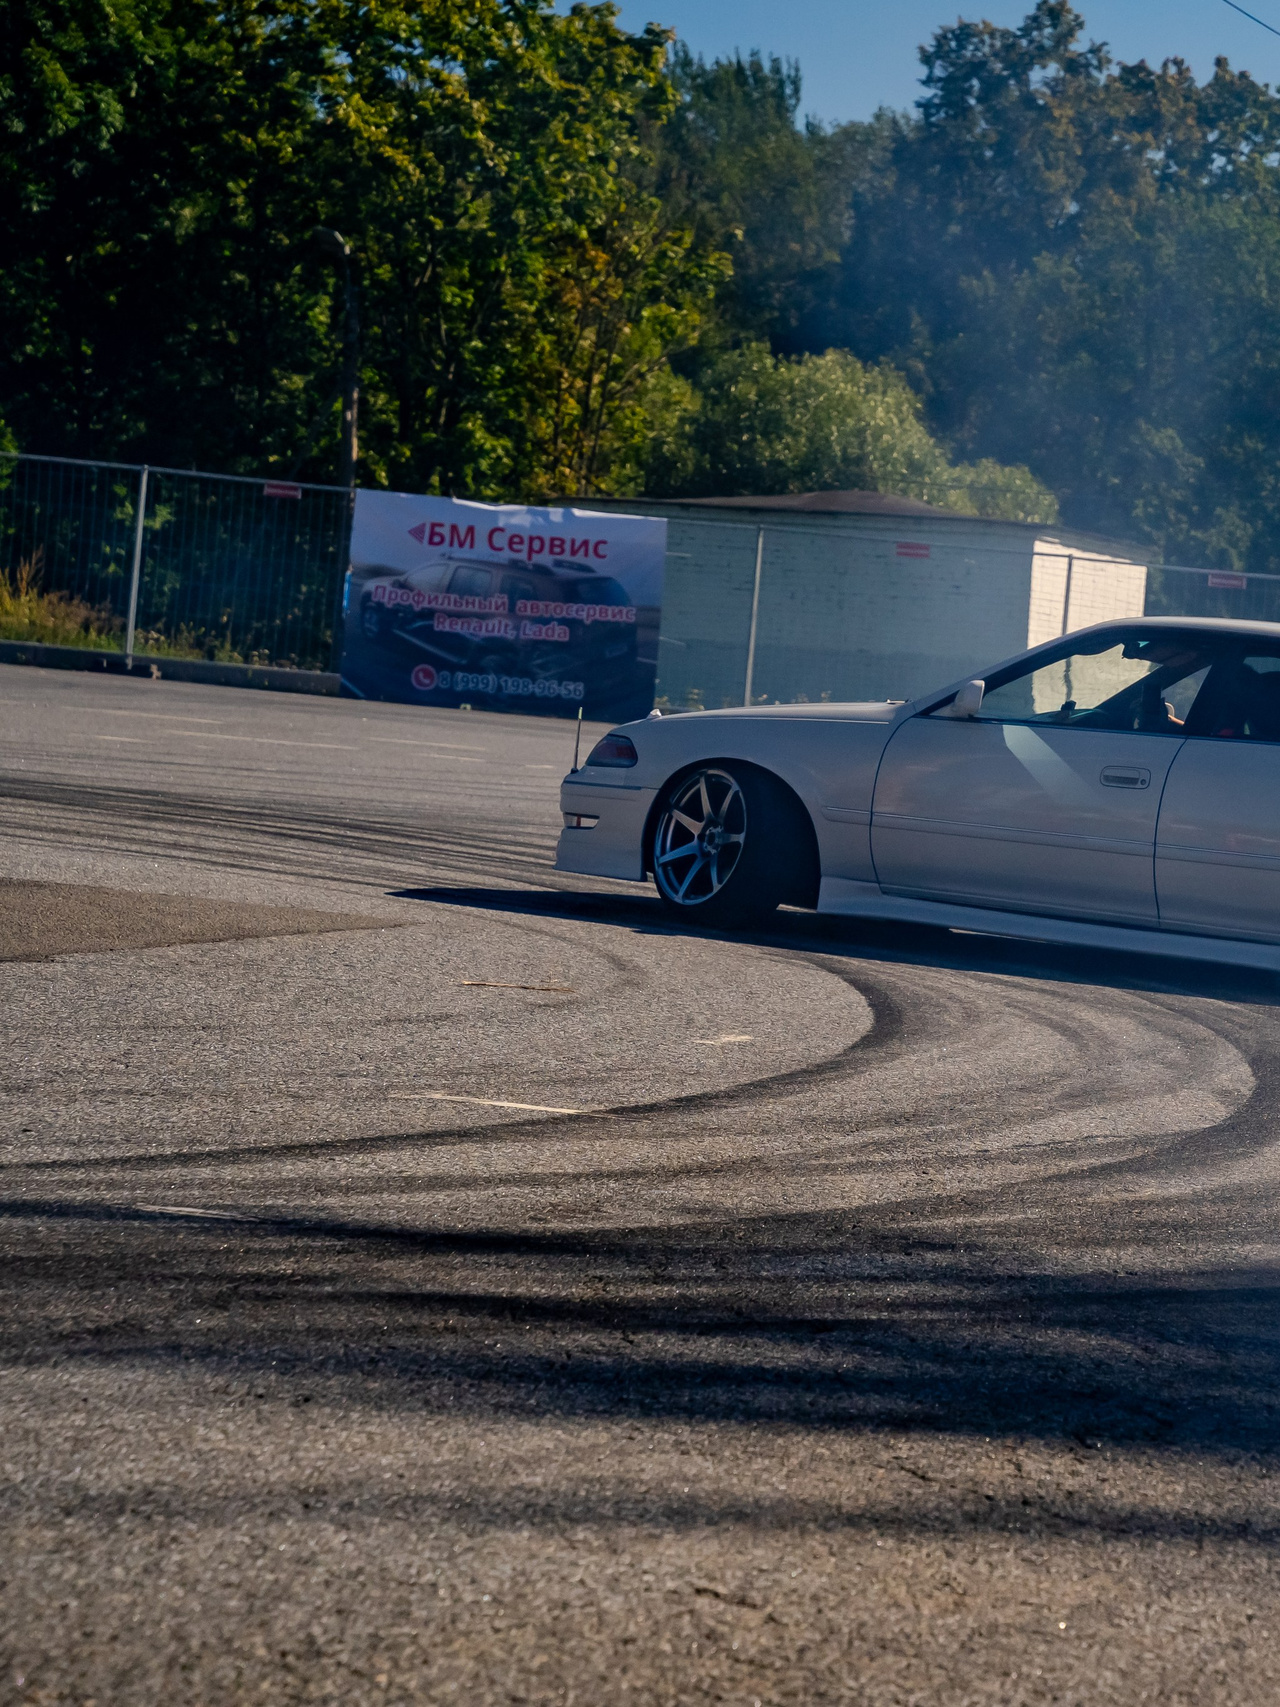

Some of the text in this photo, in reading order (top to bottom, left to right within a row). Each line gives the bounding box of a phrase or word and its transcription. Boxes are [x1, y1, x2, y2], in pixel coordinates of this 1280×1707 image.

[427, 522, 608, 561] БМ Сервис
[373, 584, 636, 623] Профильный автосервис
[435, 613, 569, 641] Renault, Lada
[439, 671, 584, 698] 8 (999) 198-96-56
